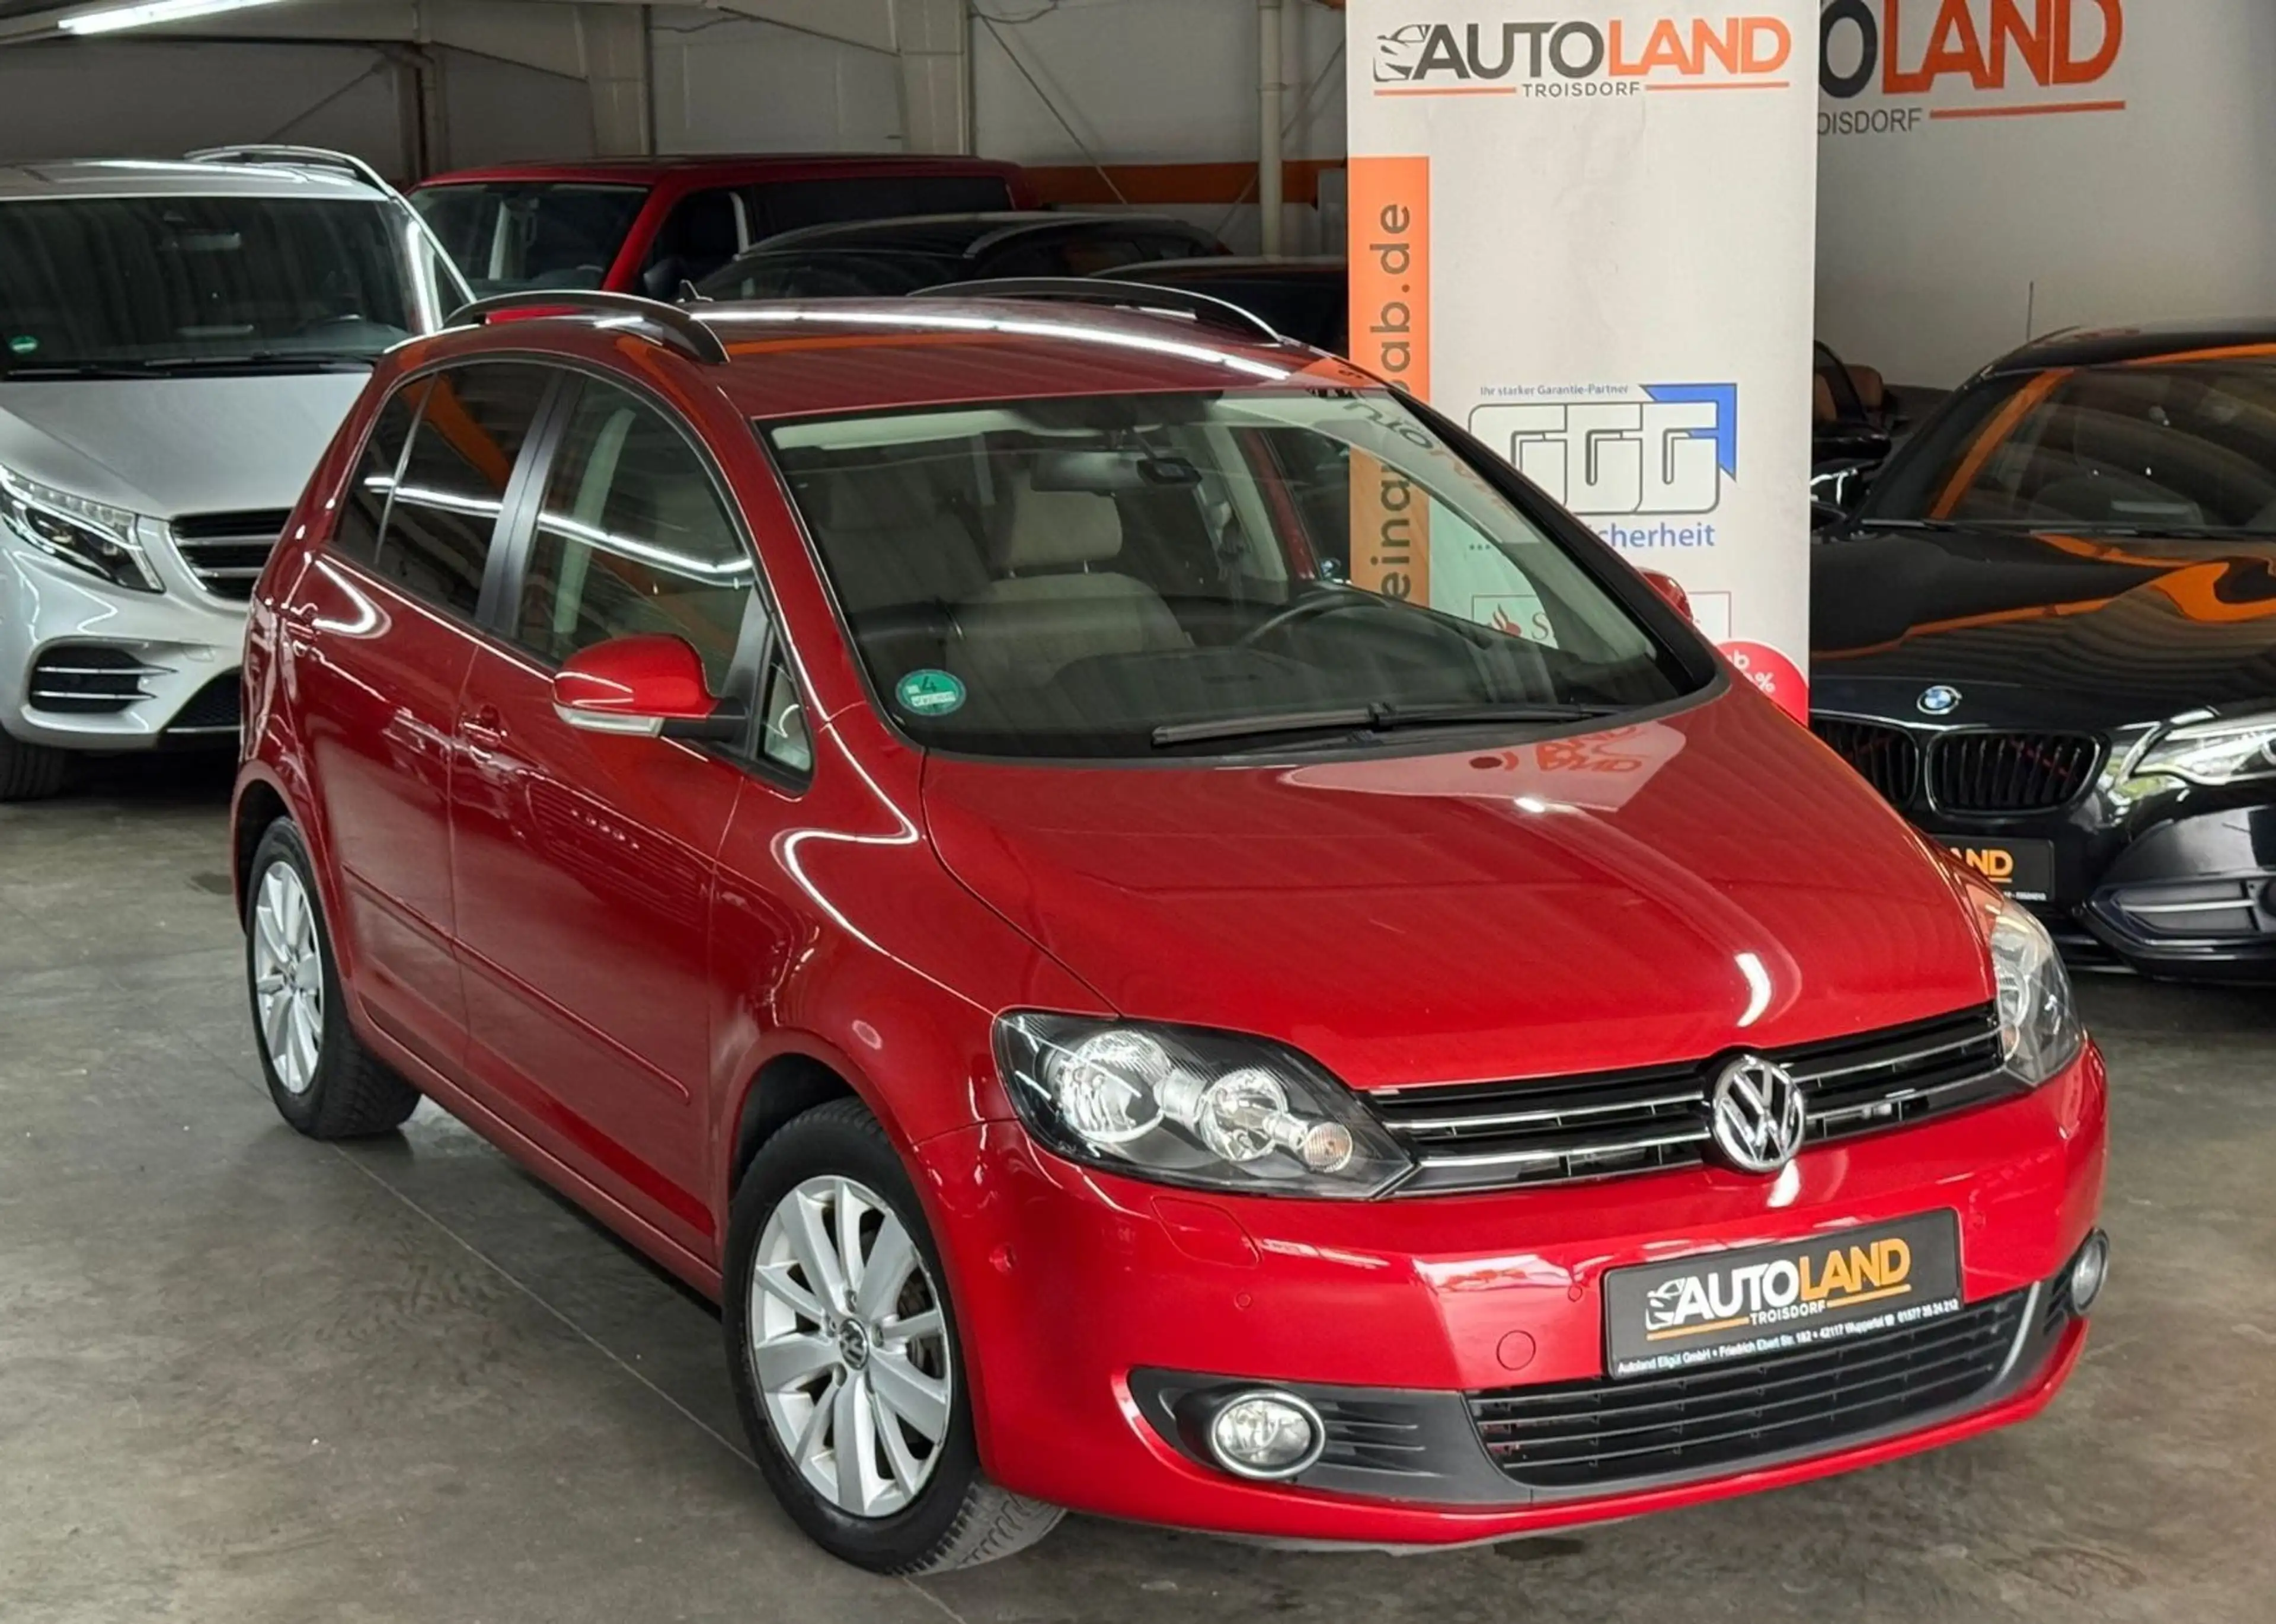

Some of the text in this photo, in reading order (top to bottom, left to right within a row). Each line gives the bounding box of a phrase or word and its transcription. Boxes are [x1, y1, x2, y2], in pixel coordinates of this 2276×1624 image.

[1412, 17, 1792, 80] AUTOLAND
[1522, 81, 1641, 98] TROISDORF
[1481, 383, 1629, 396] Ihr starker Garantie-Partner
[1673, 1238, 1911, 1324] AUTOLAND
[1749, 1300, 1826, 1326] TROISDORF
[1618, 1358, 1657, 1374] Autoland
[1682, 1348, 1711, 1364] GmbH
